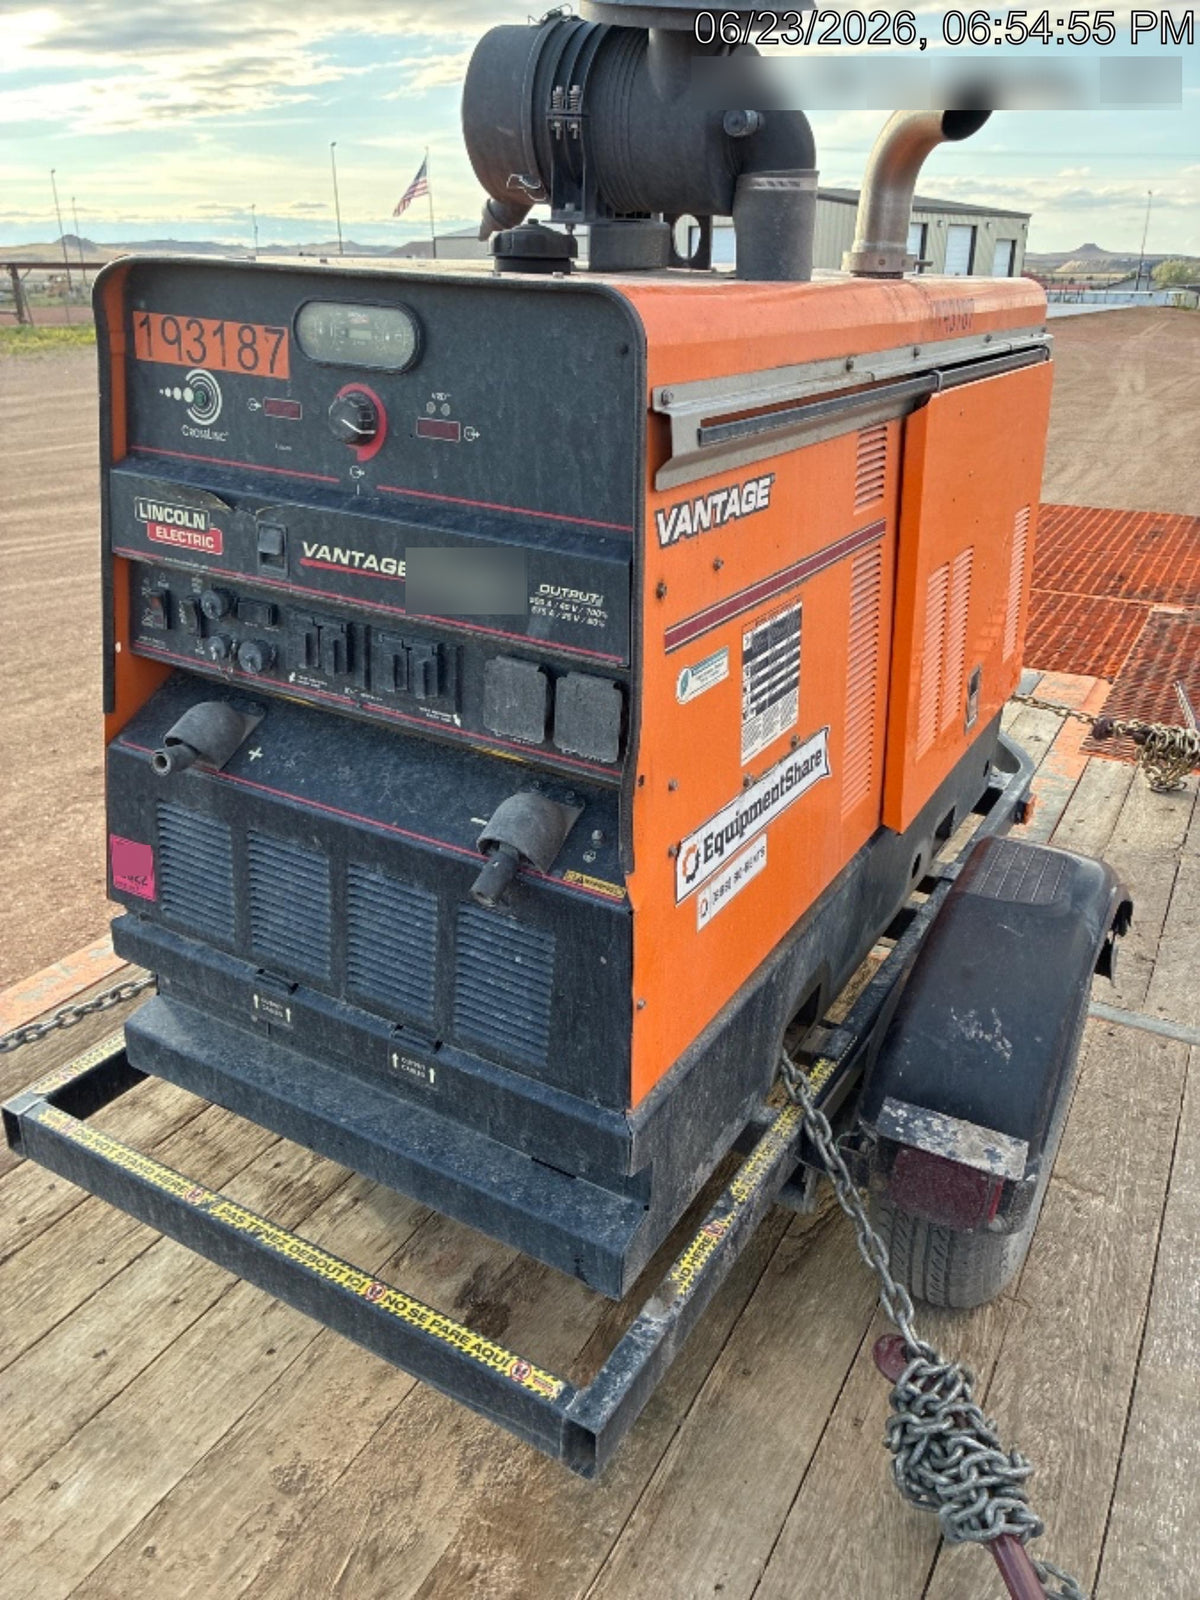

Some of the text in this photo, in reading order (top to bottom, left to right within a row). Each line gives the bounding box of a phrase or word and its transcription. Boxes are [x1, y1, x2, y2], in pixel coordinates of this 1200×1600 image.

[139, 314, 285, 374] 193187
[138, 502, 206, 530] LINCOLN
[155, 525, 215, 549] ELECTRIC
[655, 476, 772, 548] VANTAGE
[703, 749, 822, 864] EquipmentShare
[115, 1151, 156, 1176] STAND
[154, 1171, 190, 1194] HERE
[221, 1206, 247, 1226] PAS
[288, 1243, 346, 1278] DEBOUT
[385, 1294, 408, 1312] NO
[407, 1307, 432, 1324] SE
[429, 1317, 472, 1347] PARE
